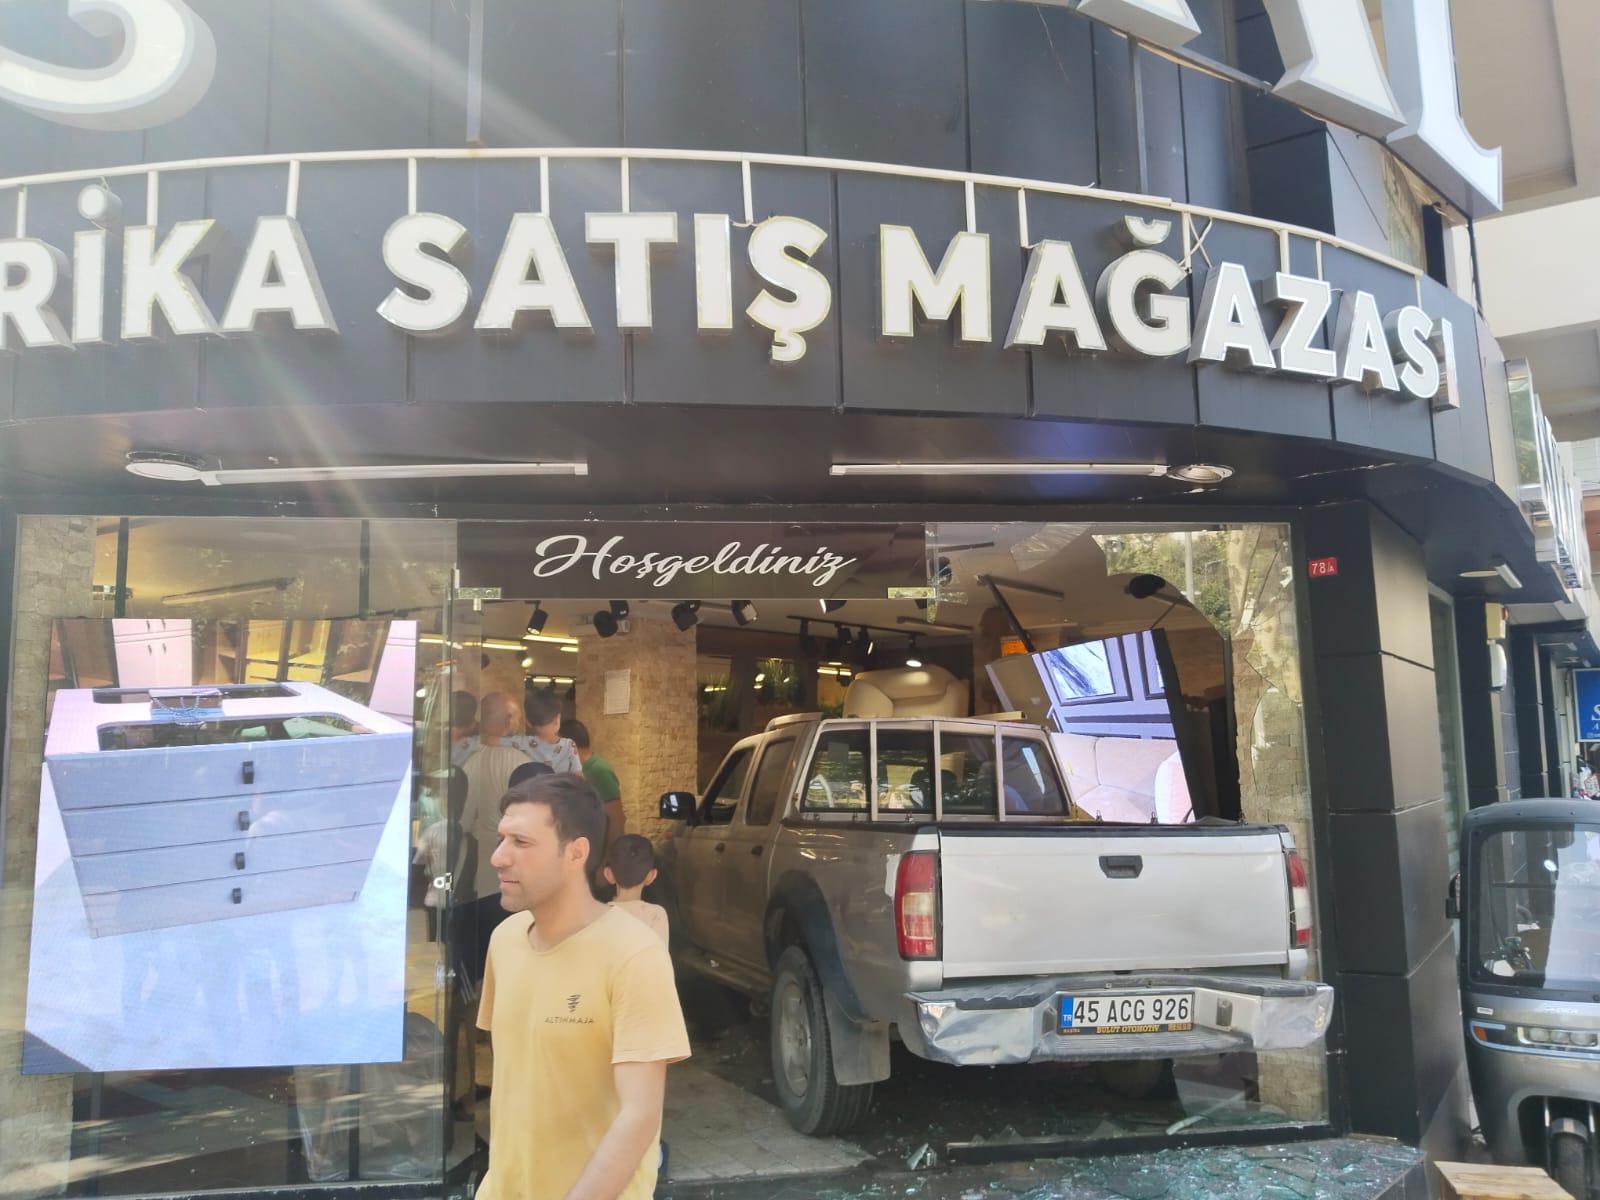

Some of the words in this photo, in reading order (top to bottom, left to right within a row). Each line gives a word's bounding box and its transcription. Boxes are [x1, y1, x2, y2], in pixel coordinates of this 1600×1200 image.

[377, 213, 831, 361] SATIŞ
[880, 215, 1459, 410] MAĞAZASI
[533, 534, 857, 587] Hoşgeldiniz
[1074, 1000, 1099, 1023] 45
[1107, 999, 1146, 1023] ACG
[1152, 998, 1189, 1021] 926
[1096, 1025, 1121, 1034] BULUT
